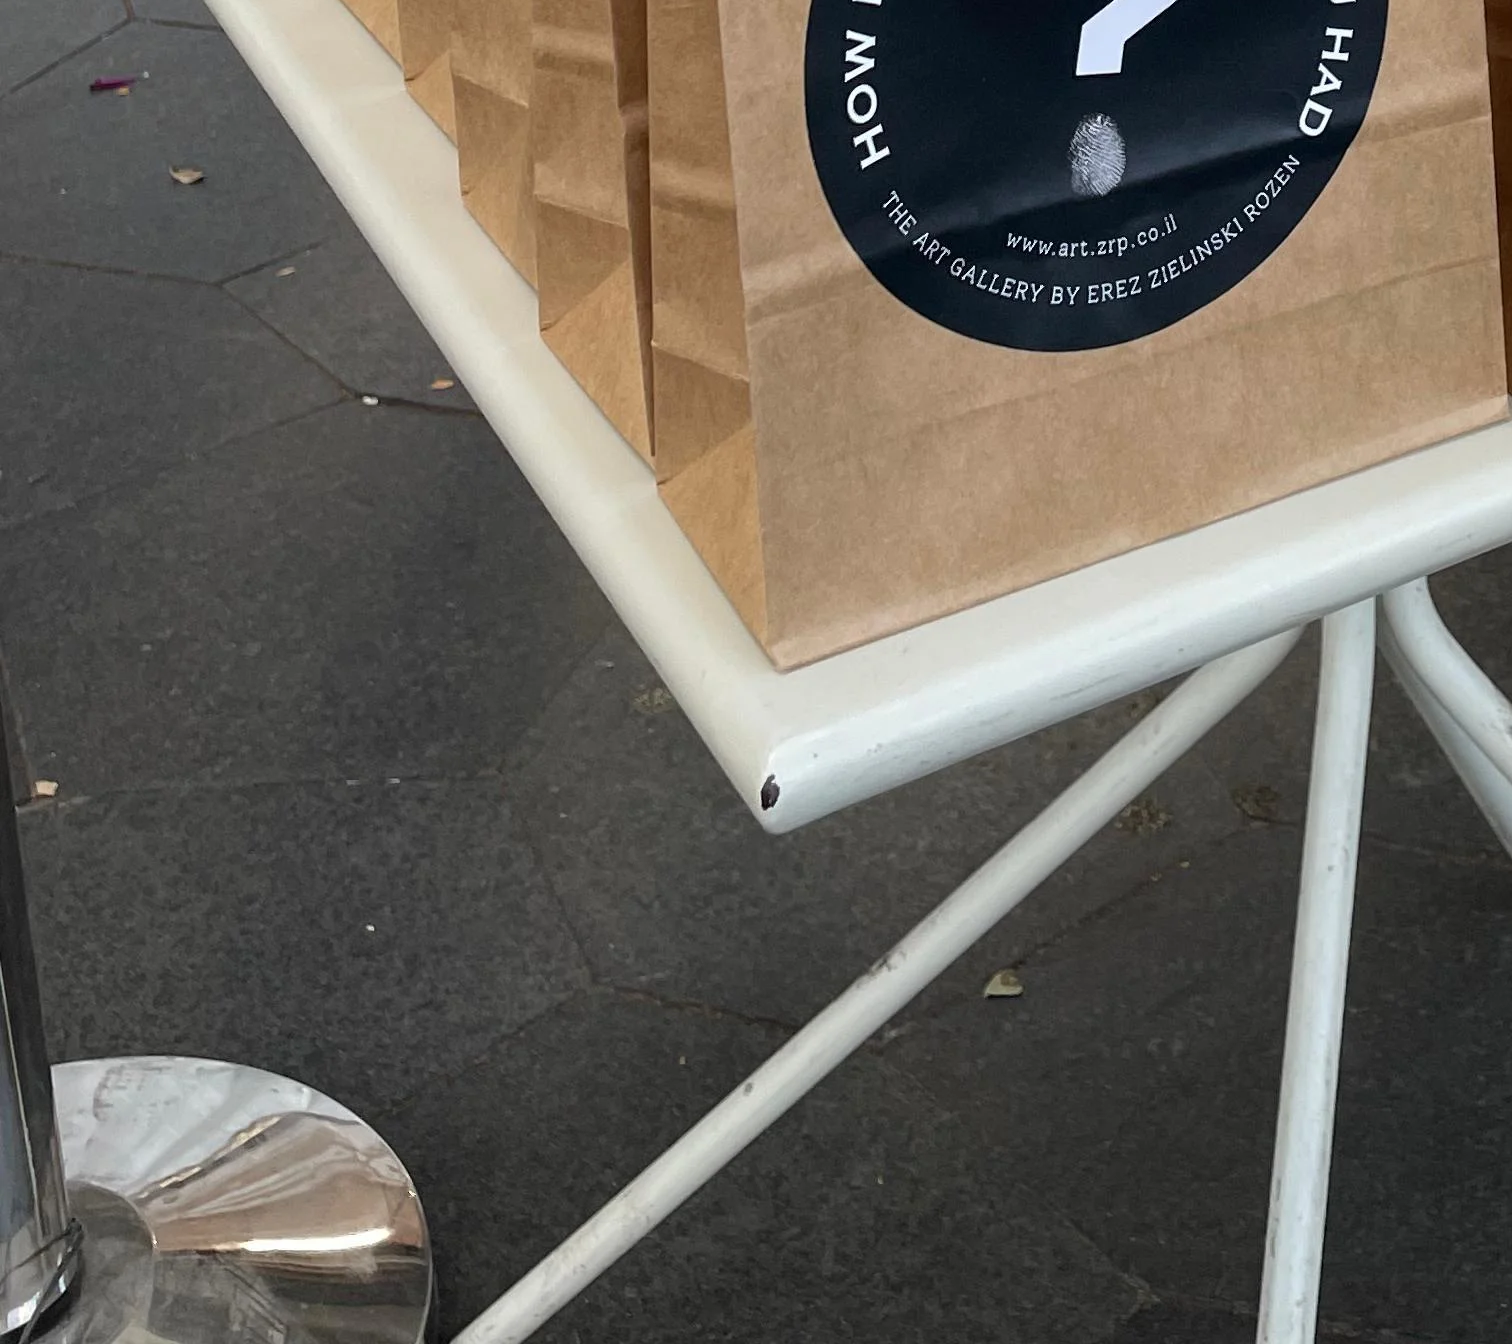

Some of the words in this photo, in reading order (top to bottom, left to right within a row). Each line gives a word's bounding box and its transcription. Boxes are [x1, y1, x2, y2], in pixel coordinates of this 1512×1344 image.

[845, 29, 891, 171] HOW
[1299, 26, 1355, 138] HAD
[881, 190, 918, 236] THE
[912, 231, 952, 266] ART
[949, 257, 1045, 304] GALLERY
[1051, 286, 1081, 306] BY
[1087, 275, 1143, 305] EREZ
[1147, 217, 1244, 291] ZIELINSKI
[1243, 154, 1301, 224] ROZEN
[1006, 213, 1179, 259] www.art.zrp.co.il
